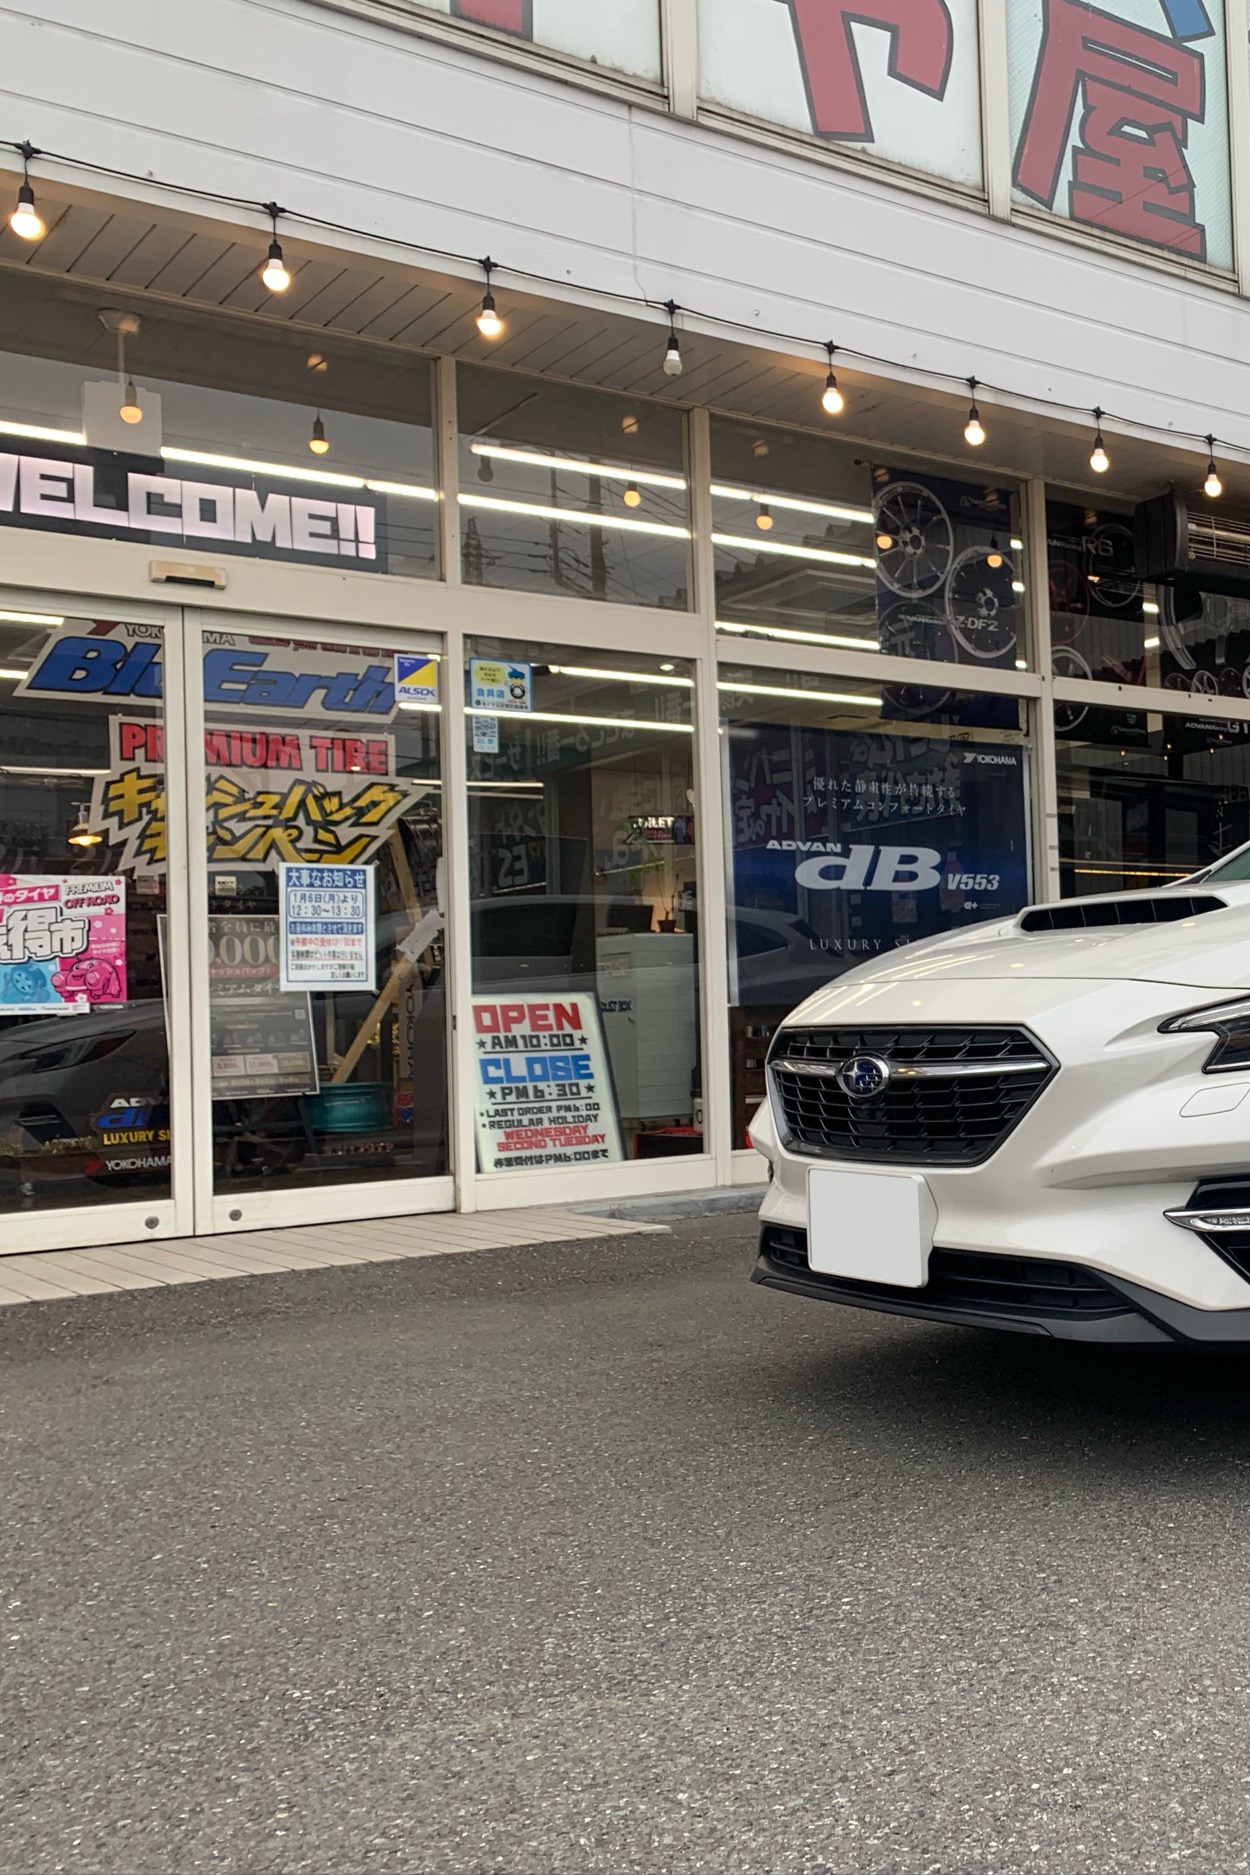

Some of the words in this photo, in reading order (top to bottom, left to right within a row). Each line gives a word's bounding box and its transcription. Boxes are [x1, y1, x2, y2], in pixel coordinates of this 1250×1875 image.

[398, 686, 436, 697] ALSOK
[119, 721, 303, 771] PRMIUM
[308, 733, 389, 776] TIRE
[976, 754, 1017, 766] YOKOHAMA
[765, 839, 842, 853] ADVAN
[794, 844, 942, 892] dB
[288, 867, 366, 888] 大事なお知らせ
[946, 873, 1000, 891] V553
[808, 938, 883, 951] LUXURY
[472, 1002, 583, 1034] OPEN
[478, 1054, 595, 1085] CLOSE
[486, 1107, 516, 1119] LAST
[517, 1105, 553, 1117] ORDER
[488, 1117, 544, 1130] REGULAR
[548, 1113, 599, 1126] HOLIDAY
[103, 1130, 155, 1146] LUXURY
[503, 1124, 589, 1142] WEDNESDAY
[496, 1138, 548, 1153] SECOND
[550, 1133, 606, 1149] TUESDAY
[105, 1155, 171, 1171] YOKOHAMA
